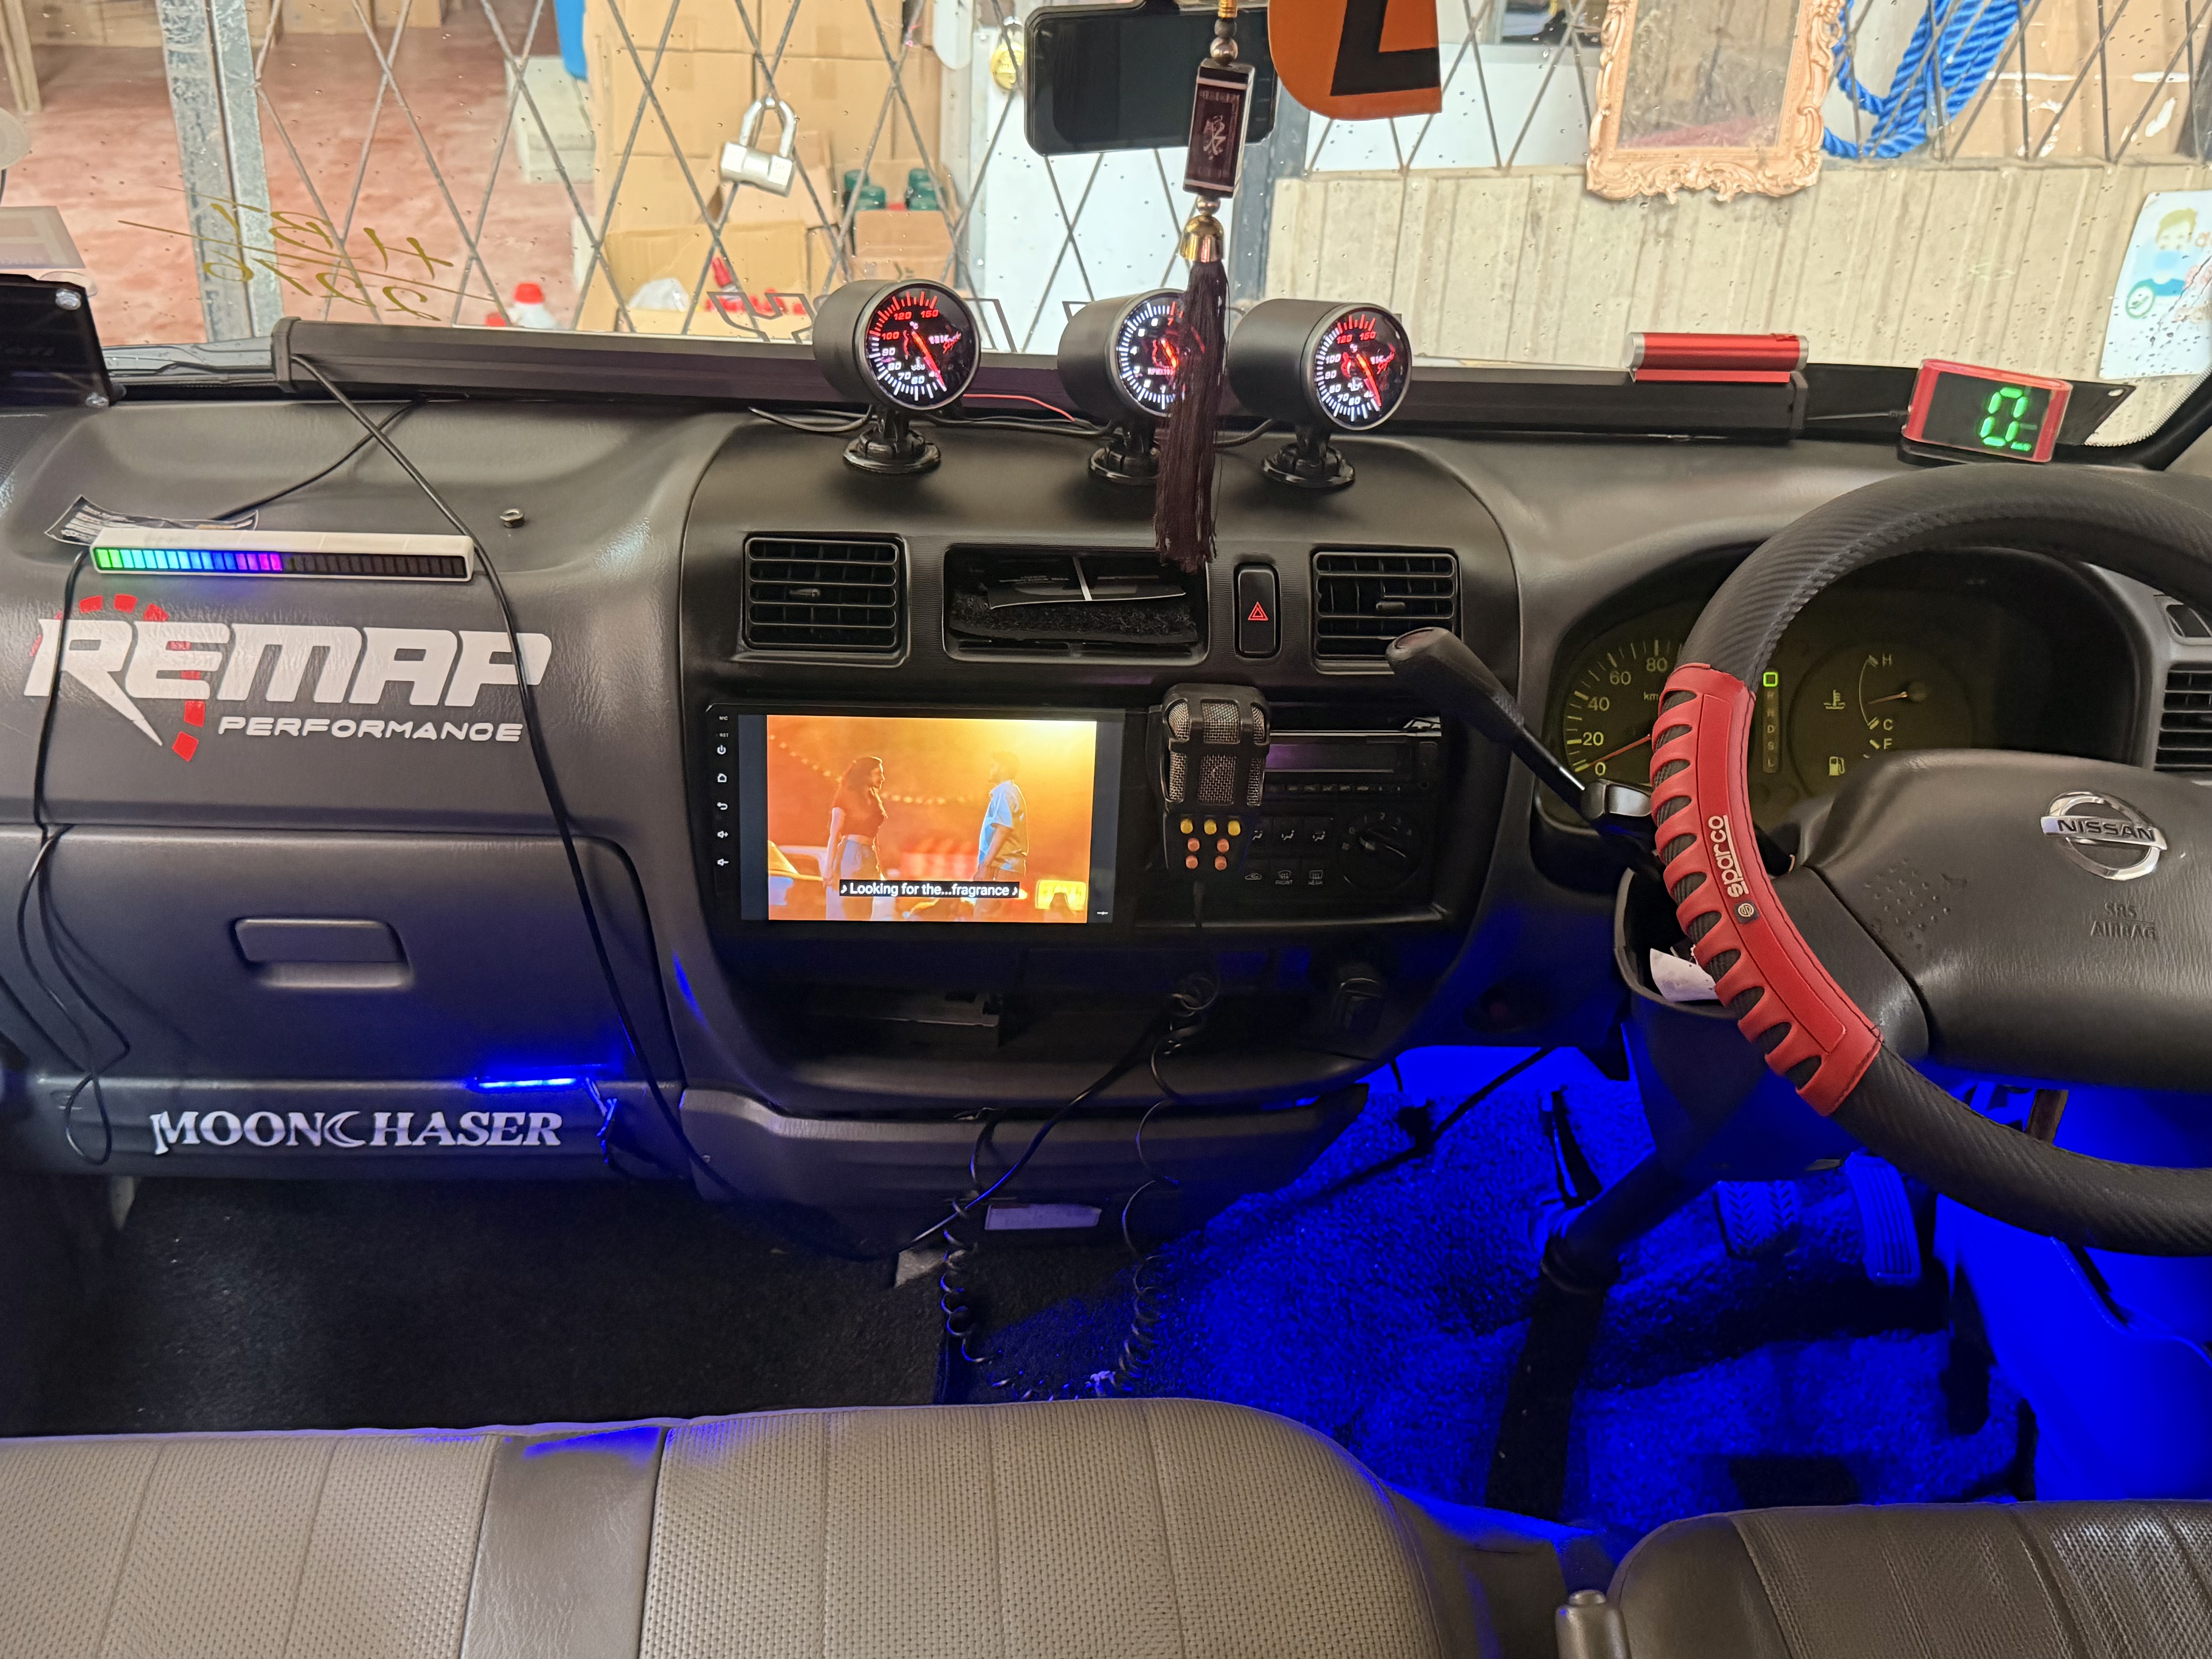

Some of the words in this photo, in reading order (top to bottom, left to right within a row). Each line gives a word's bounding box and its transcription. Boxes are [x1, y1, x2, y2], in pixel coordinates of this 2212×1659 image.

[893, 311, 912, 320] 120
[882, 331, 900, 340] 100
[1337, 335, 1353, 343] 120
[1360, 331, 1376, 340] 150
[882, 347, 895, 356] 90
[1325, 354, 1341, 364] 100
[898, 372, 911, 380] 70
[911, 376, 925, 385] 60
[1325, 370, 1336, 380] 90
[1338, 393, 1349, 402] 70
[1979, 387, 2028, 447] 0
[1646, 657, 1668, 672] 80
[1882, 654, 1893, 666] H
[24, 619, 552, 746] REMAP
[1609, 671, 1632, 685] 60
[1588, 697, 1610, 711] 40
[219, 716, 523, 742] PERFORMANCE
[1767, 725, 1774, 733] D
[1883, 719, 1894, 731] C
[1583, 732, 1604, 746] 20
[1884, 738, 1893, 749] F
[1595, 762, 1606, 776] 0
[2057, 819, 2155, 842] NISSAN
[1708, 815, 1749, 898] sparco
[850, 882, 898, 897] Looking
[902, 883, 919, 895] for
